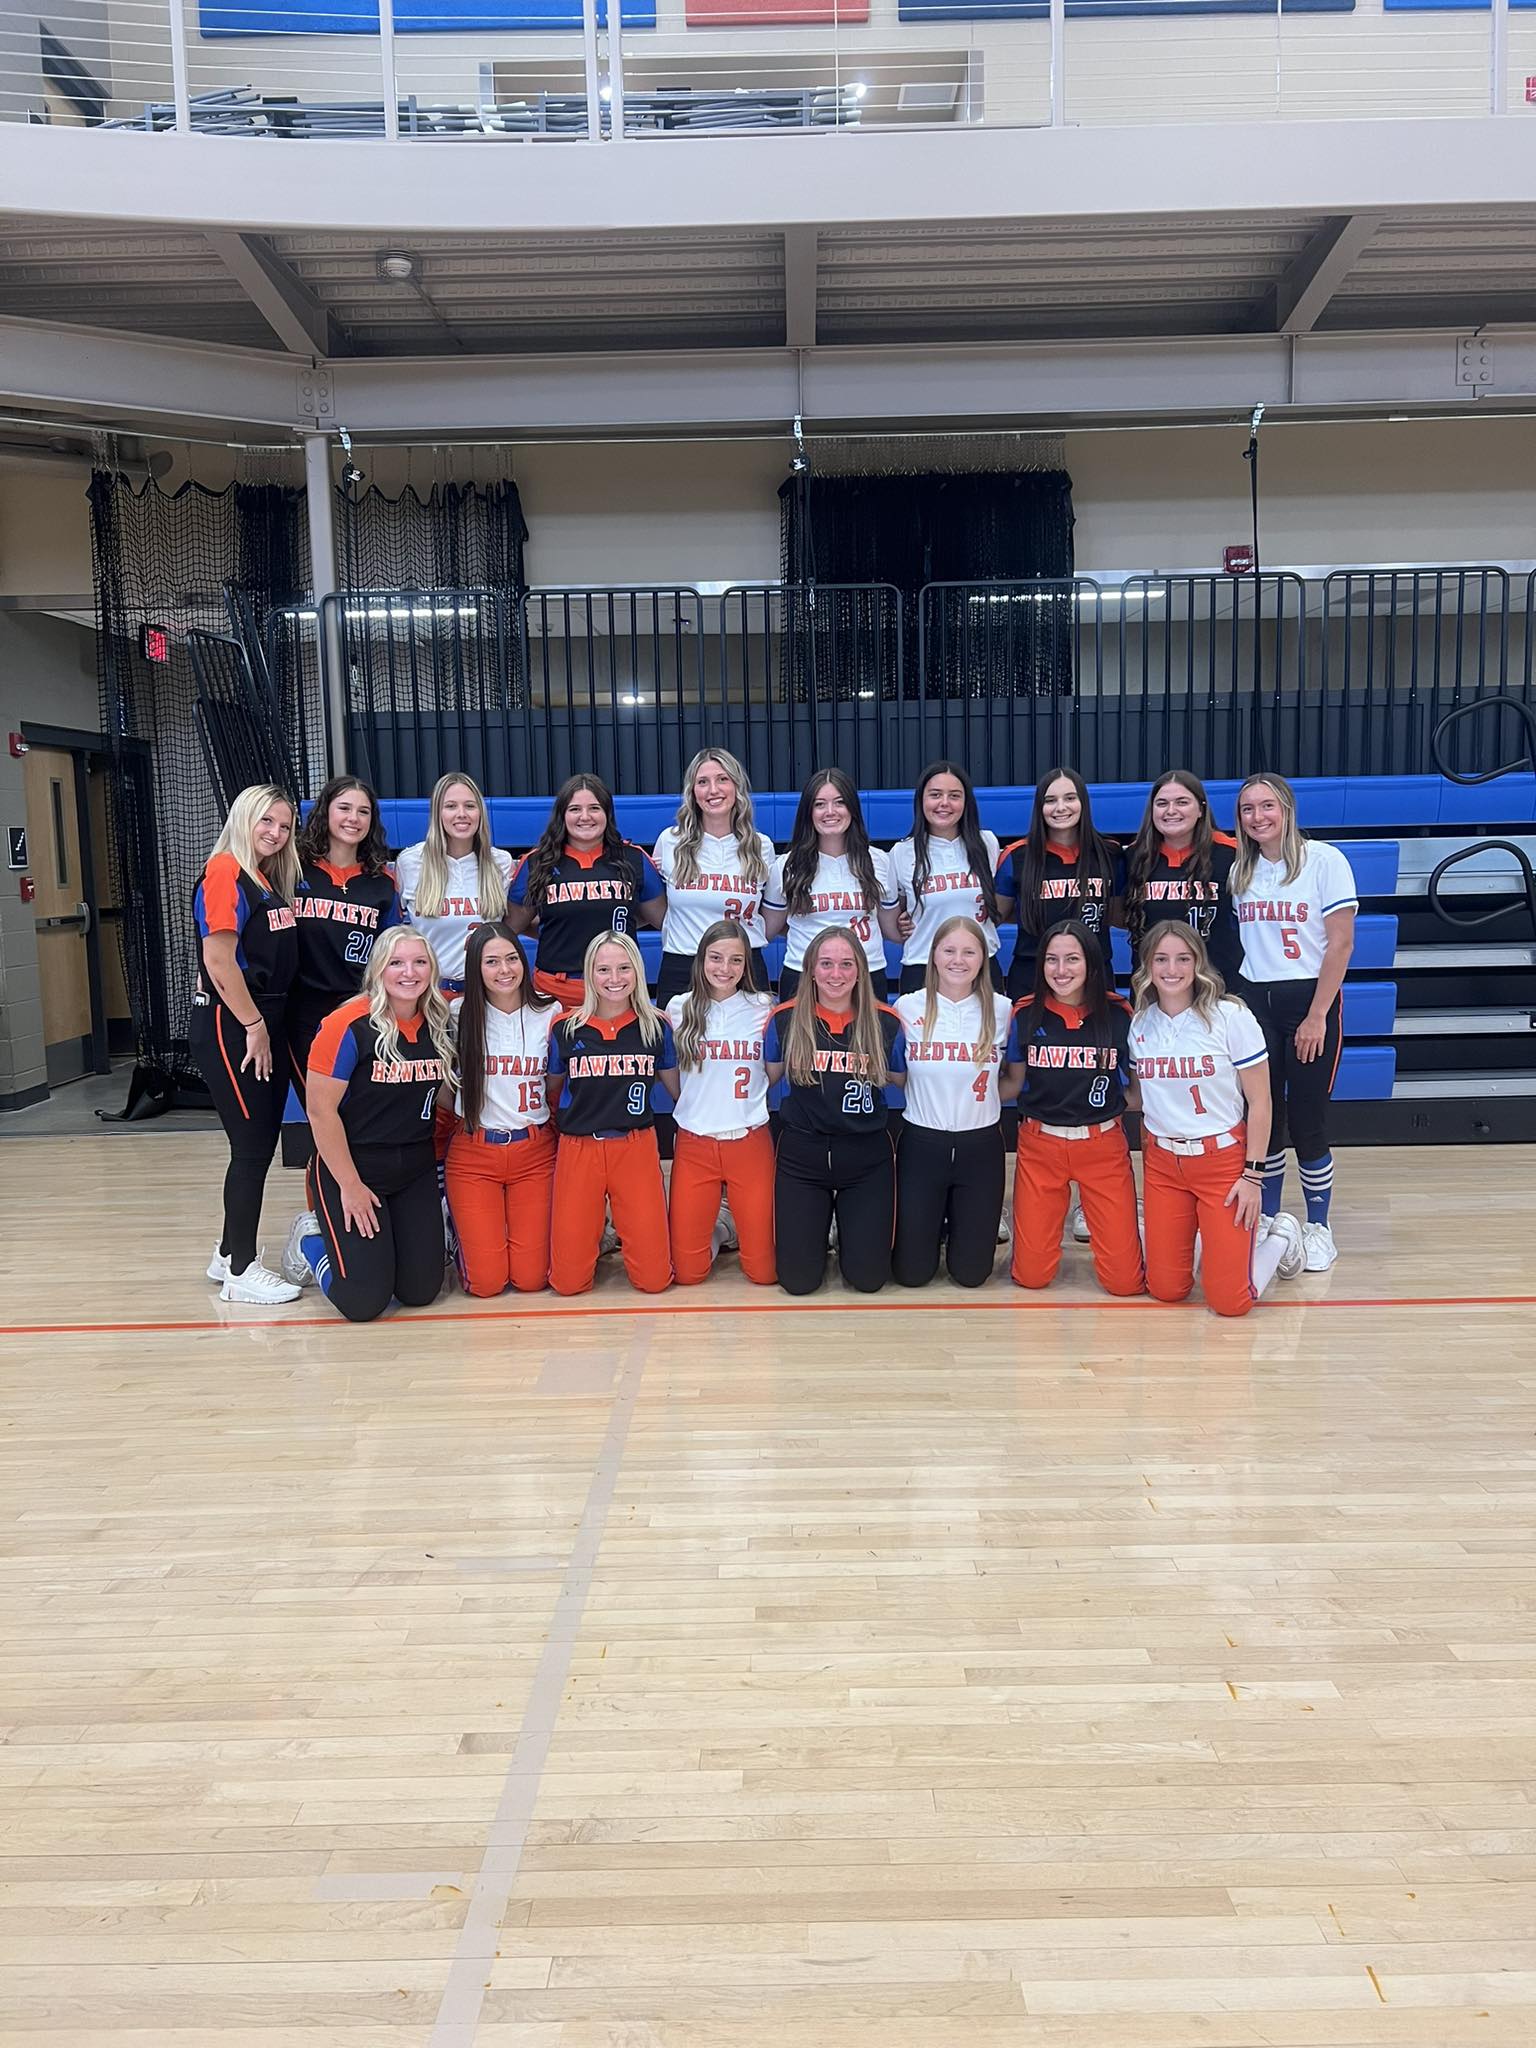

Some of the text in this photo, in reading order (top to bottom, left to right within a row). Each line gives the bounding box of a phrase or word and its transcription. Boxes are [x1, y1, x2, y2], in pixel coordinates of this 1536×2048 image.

[293, 897, 380, 930] HAWKEYE
[612, 906, 629, 934] 6
[345, 930, 374, 964] 21
[1280, 927, 1302, 960] 5
[485, 1055, 548, 1077] DTAILS
[696, 1039, 761, 1061] DTAILS
[908, 1041, 998, 1063] REDTAS
[569, 1054, 655, 1079] HAWKEYE
[734, 1066, 752, 1099] 2
[517, 1080, 543, 1113] 15
[627, 1082, 647, 1115] 9
[842, 1080, 874, 1114] 28
[972, 1070, 991, 1102] 4
[1088, 1075, 1111, 1108] 8
[1189, 1084, 1208, 1115] 1
[420, 1087, 436, 1119] 1
